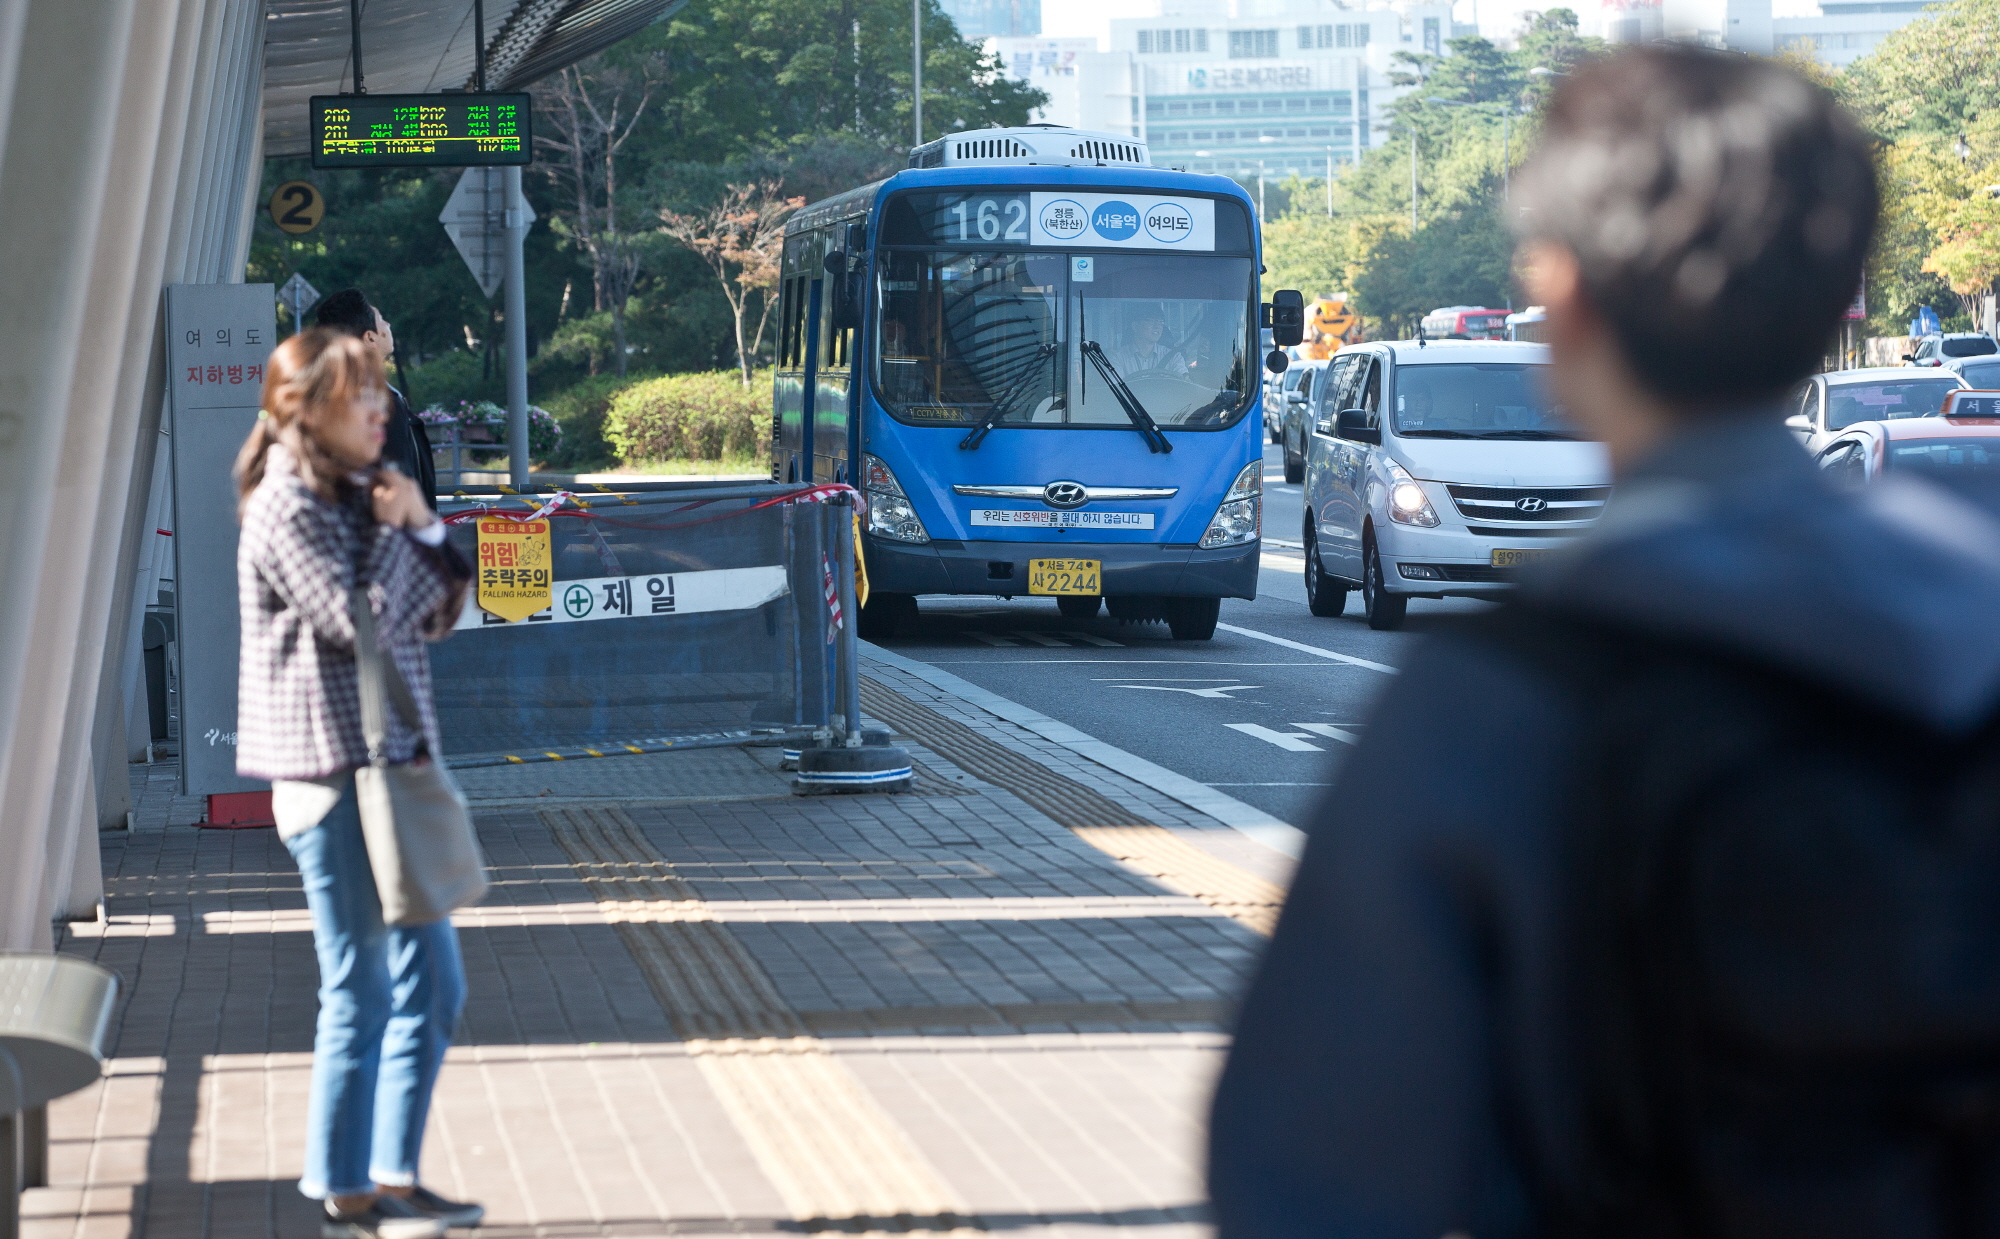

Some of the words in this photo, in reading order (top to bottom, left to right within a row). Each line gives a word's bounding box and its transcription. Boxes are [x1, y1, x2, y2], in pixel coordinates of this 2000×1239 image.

[280, 184, 313, 226] 2
[1054, 208, 1075, 219] 정릉
[951, 199, 1028, 241] 162
[1044, 219, 1083, 230] (북한산)
[1095, 213, 1137, 230] 서울역
[1148, 215, 1190, 231] 여의도
[186, 328, 262, 348] 여의도
[187, 364, 263, 386] 지하벙커
[916, 409, 935, 418] CCTV
[983, 510, 1010, 522] 우리는
[1013, 511, 1058, 524] 신호위반을
[1061, 512, 1080, 524] 절대
[1082, 513, 1101, 524] 하지
[1103, 513, 1142, 526] 않습니다.
[488, 524, 505, 533] 안전
[519, 524, 536, 533] 제일
[480, 542, 519, 568] 위험!
[1046, 560, 1065, 571] 서울
[1067, 561, 1084, 571] 74
[482, 569, 549, 588] 추락주의
[602, 576, 677, 616] 제일
